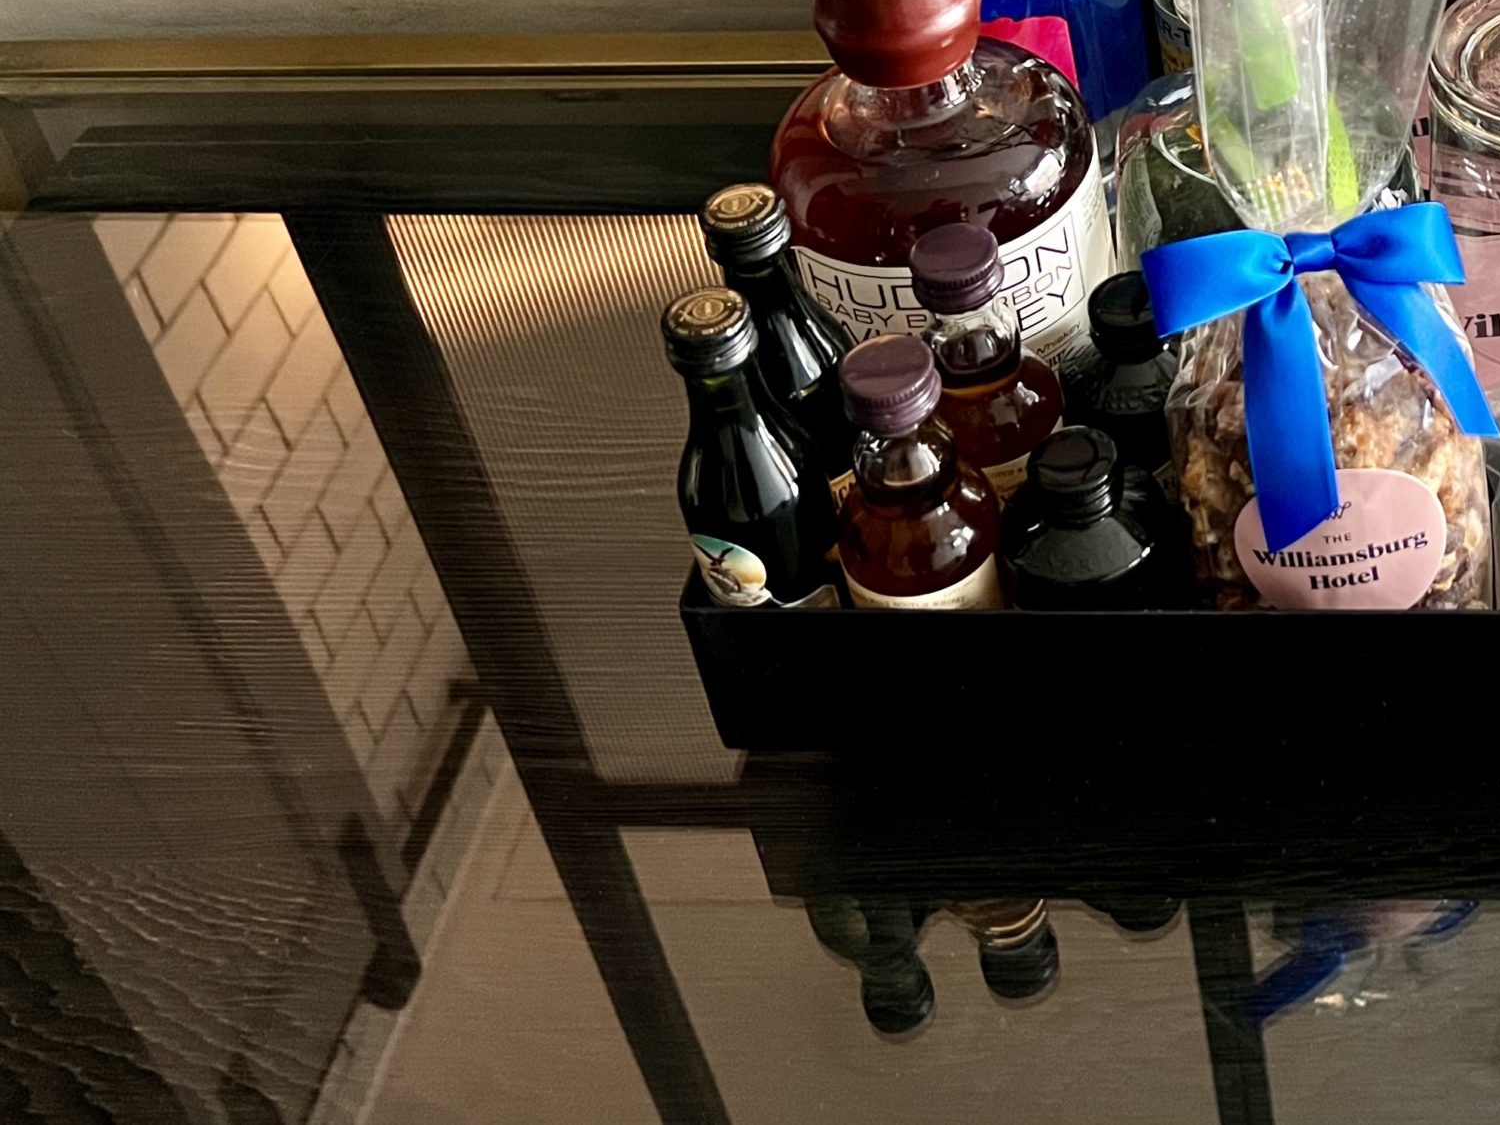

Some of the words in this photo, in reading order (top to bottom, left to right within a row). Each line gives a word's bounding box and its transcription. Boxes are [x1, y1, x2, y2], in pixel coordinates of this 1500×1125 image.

[816, 292, 893, 327] BABY
[1253, 530, 1429, 568] Williamsburg
[1323, 532, 1352, 545] THE
[1309, 566, 1380, 590] Hotel
